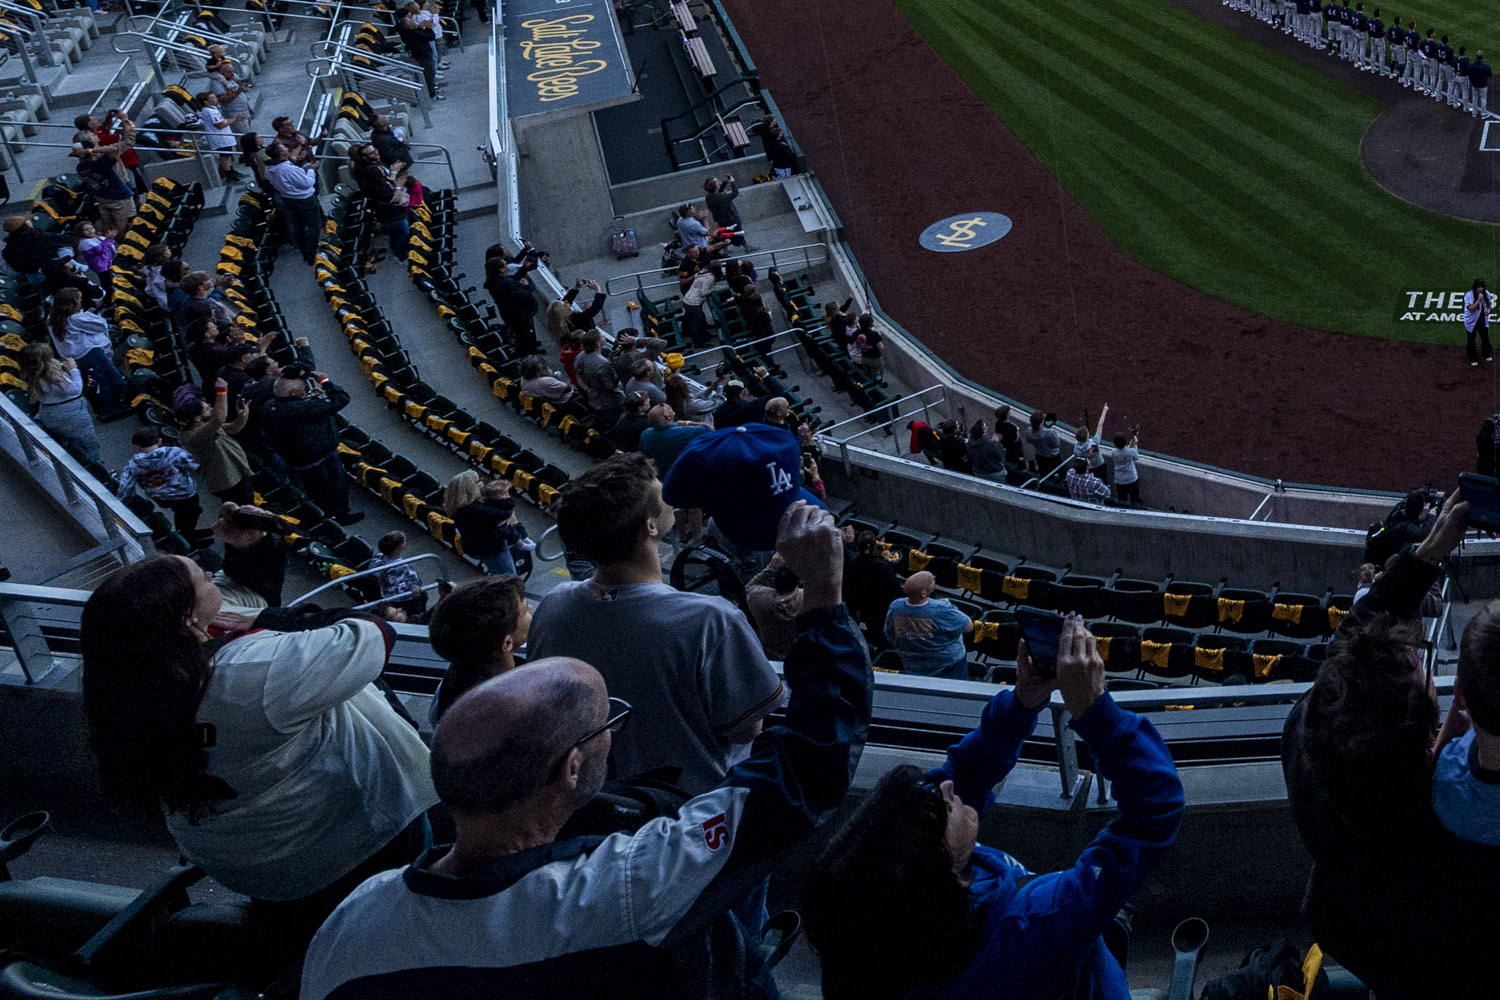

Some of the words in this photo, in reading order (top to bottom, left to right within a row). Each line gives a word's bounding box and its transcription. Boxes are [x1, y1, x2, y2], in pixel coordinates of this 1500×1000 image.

[521, 14, 595, 42] Salt
[519, 37, 602, 69] Lake
[526, 59, 608, 102] Bees
[1406, 291, 1464, 308] THE
[1400, 312, 1424, 321] AT
[766, 461, 793, 496] LA
